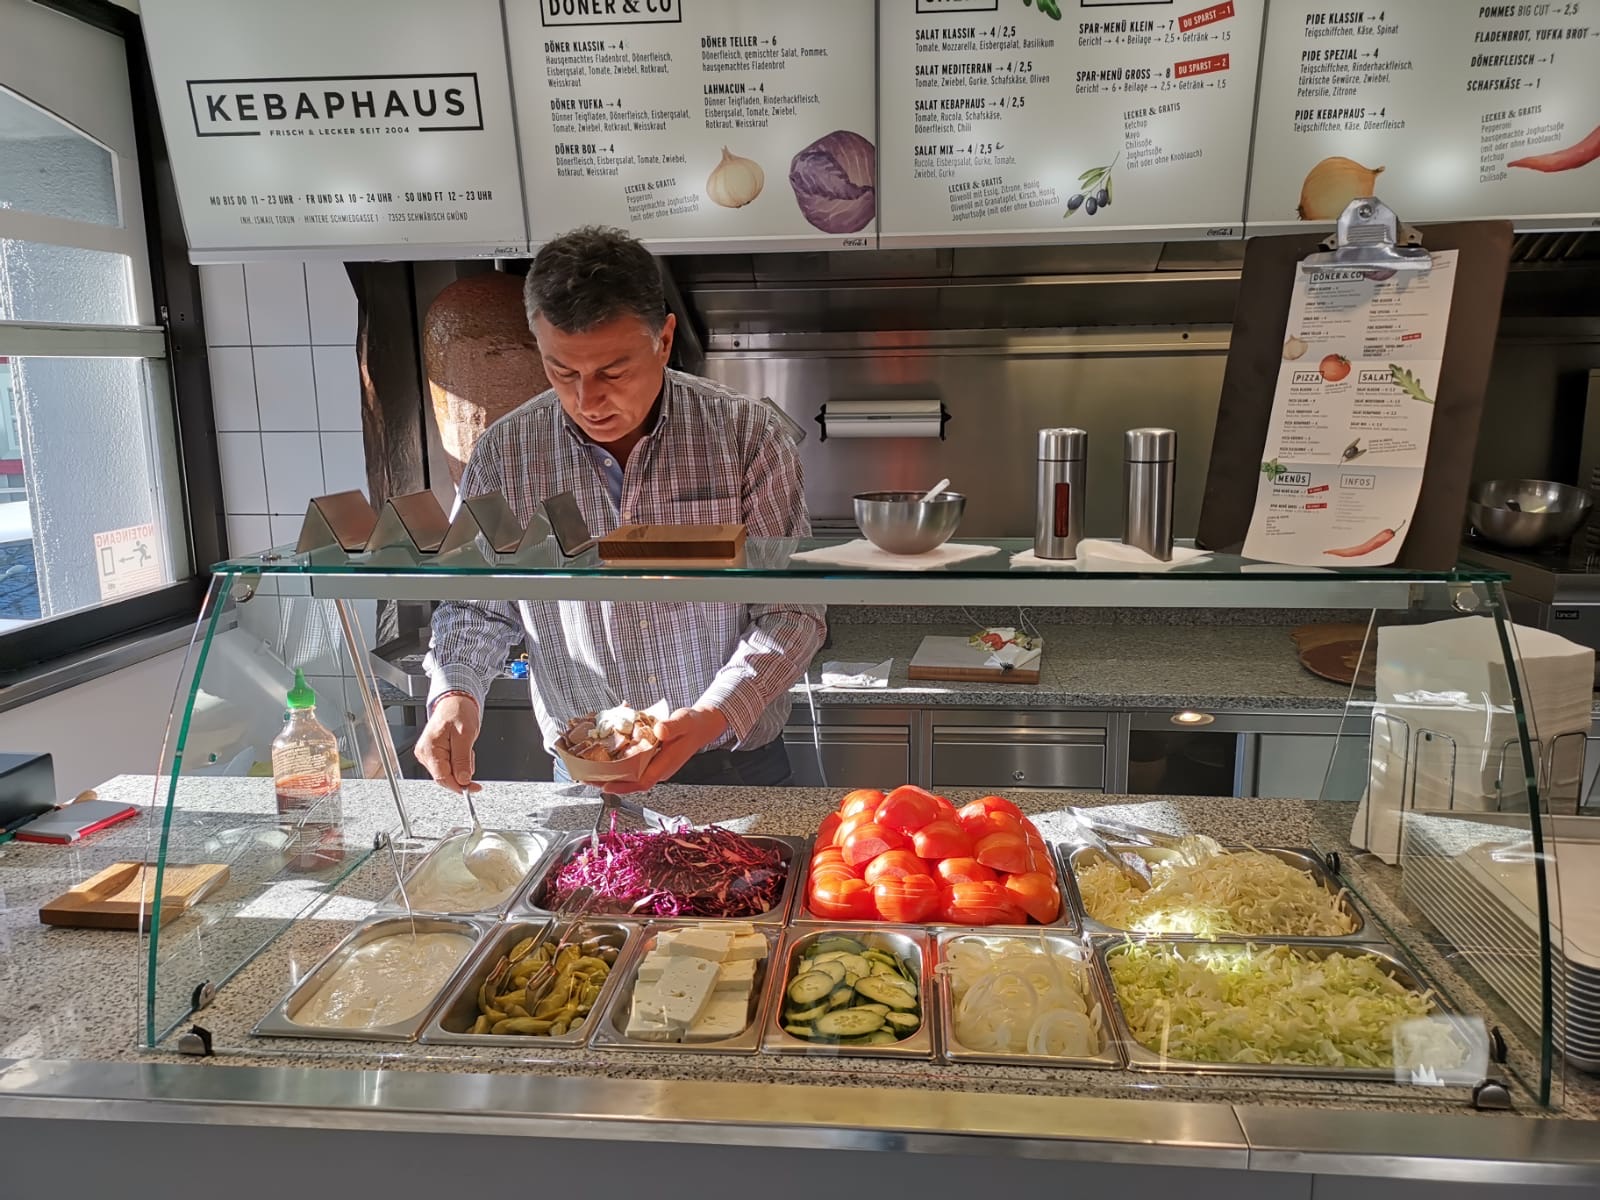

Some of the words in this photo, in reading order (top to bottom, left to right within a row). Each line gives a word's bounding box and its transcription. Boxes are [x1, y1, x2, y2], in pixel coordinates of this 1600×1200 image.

[1183, 18, 1192, 28] DU
[1194, 11, 1217, 25] SPARST
[1227, 6, 1230, 14] 1
[1479, 5, 1515, 18] POMMES
[1518, 5, 1532, 16] BIG
[1534, 4, 1550, 16] CUT
[1564, 3, 1578, 16] 2,5
[1306, 14, 1326, 25] PIDE
[1329, 12, 1364, 24] KLASSIK
[1379, 11, 1384, 22] 4
[1080, 20, 1126, 34] SPAR-MENÜ
[1130, 20, 1153, 32] KLEIN
[1169, 20, 1174, 31] 7
[916, 29, 939, 40] SALAT
[943, 28, 975, 39] KLASSIK
[1474, 30, 1531, 42] FLADENBROT,
[1536, 29, 1563, 40] YUFKA
[1566, 28, 1589, 40] BROT
[545, 41, 570, 53] DÖNER
[573, 41, 604, 52] KLASSIK
[619, 40, 624, 50] 4
[701, 36, 727, 48] DÖNER
[730, 36, 757, 47] TELLER
[772, 36, 776, 46] 6
[1302, 50, 1321, 61] PIDE
[1324, 49, 1357, 60] SPEZIAL
[1373, 48, 1378, 58] 4
[1471, 53, 1535, 67] DÖNERFLEISCH
[1550, 53, 1554, 64] 1
[916, 65, 939, 76] SALAT
[942, 63, 992, 75] MEDITERRAN
[1179, 66, 1187, 74] DU
[1188, 62, 1211, 73] SPARST
[1222, 59, 1226, 67] 2
[1076, 68, 1122, 82] SPAR-MENÜ
[1125, 68, 1150, 80] GROSS
[1166, 68, 1170, 78] 8
[704, 83, 745, 94] LAHMACUN
[760, 82, 764, 93] 4
[1467, 77, 1521, 91] SCHAFSKÄSE
[1536, 78, 1540, 88] 1
[206, 88, 464, 121] KEBAPHAUS
[550, 99, 576, 110] DÖNER
[578, 99, 603, 110] YUFKA
[617, 98, 621, 108] 4
[915, 100, 938, 110] SALAT
[941, 98, 985, 110] KEBAPHAUS
[1124, 108, 1147, 120] LECKER
[1148, 107, 1156, 116] &
[1158, 102, 1180, 114] GRATIS
[1295, 110, 1314, 120] PIDE
[1317, 108, 1365, 120] KEBAPHAUS
[1380, 108, 1385, 117] 4
[555, 143, 579, 154] DÖNER
[582, 144, 596, 154] BOX
[610, 144, 614, 153] 4
[915, 145, 937, 156] SALAT
[940, 145, 953, 155] MIX
[210, 196, 220, 206] MO
[223, 196, 235, 205] BIS
[237, 195, 247, 205] DO
[251, 196, 258, 205] 11
[267, 195, 276, 205] 23
[278, 194, 294, 204] UHR
[306, 194, 315, 204] FR
[317, 194, 332, 204] UND
[335, 194, 344, 204] SA
[348, 194, 356, 203] 10
[366, 193, 375, 202] 24
[377, 193, 392, 202] UHR
[405, 192, 414, 202] SO
[417, 192, 432, 202] UND
[434, 192, 442, 201] FT
[448, 192, 456, 201] 12
[466, 191, 475, 200] 23
[477, 191, 492, 200] UHR
[1362, 373, 1389, 381] SALAT
[1344, 478, 1371, 486] INFOS
